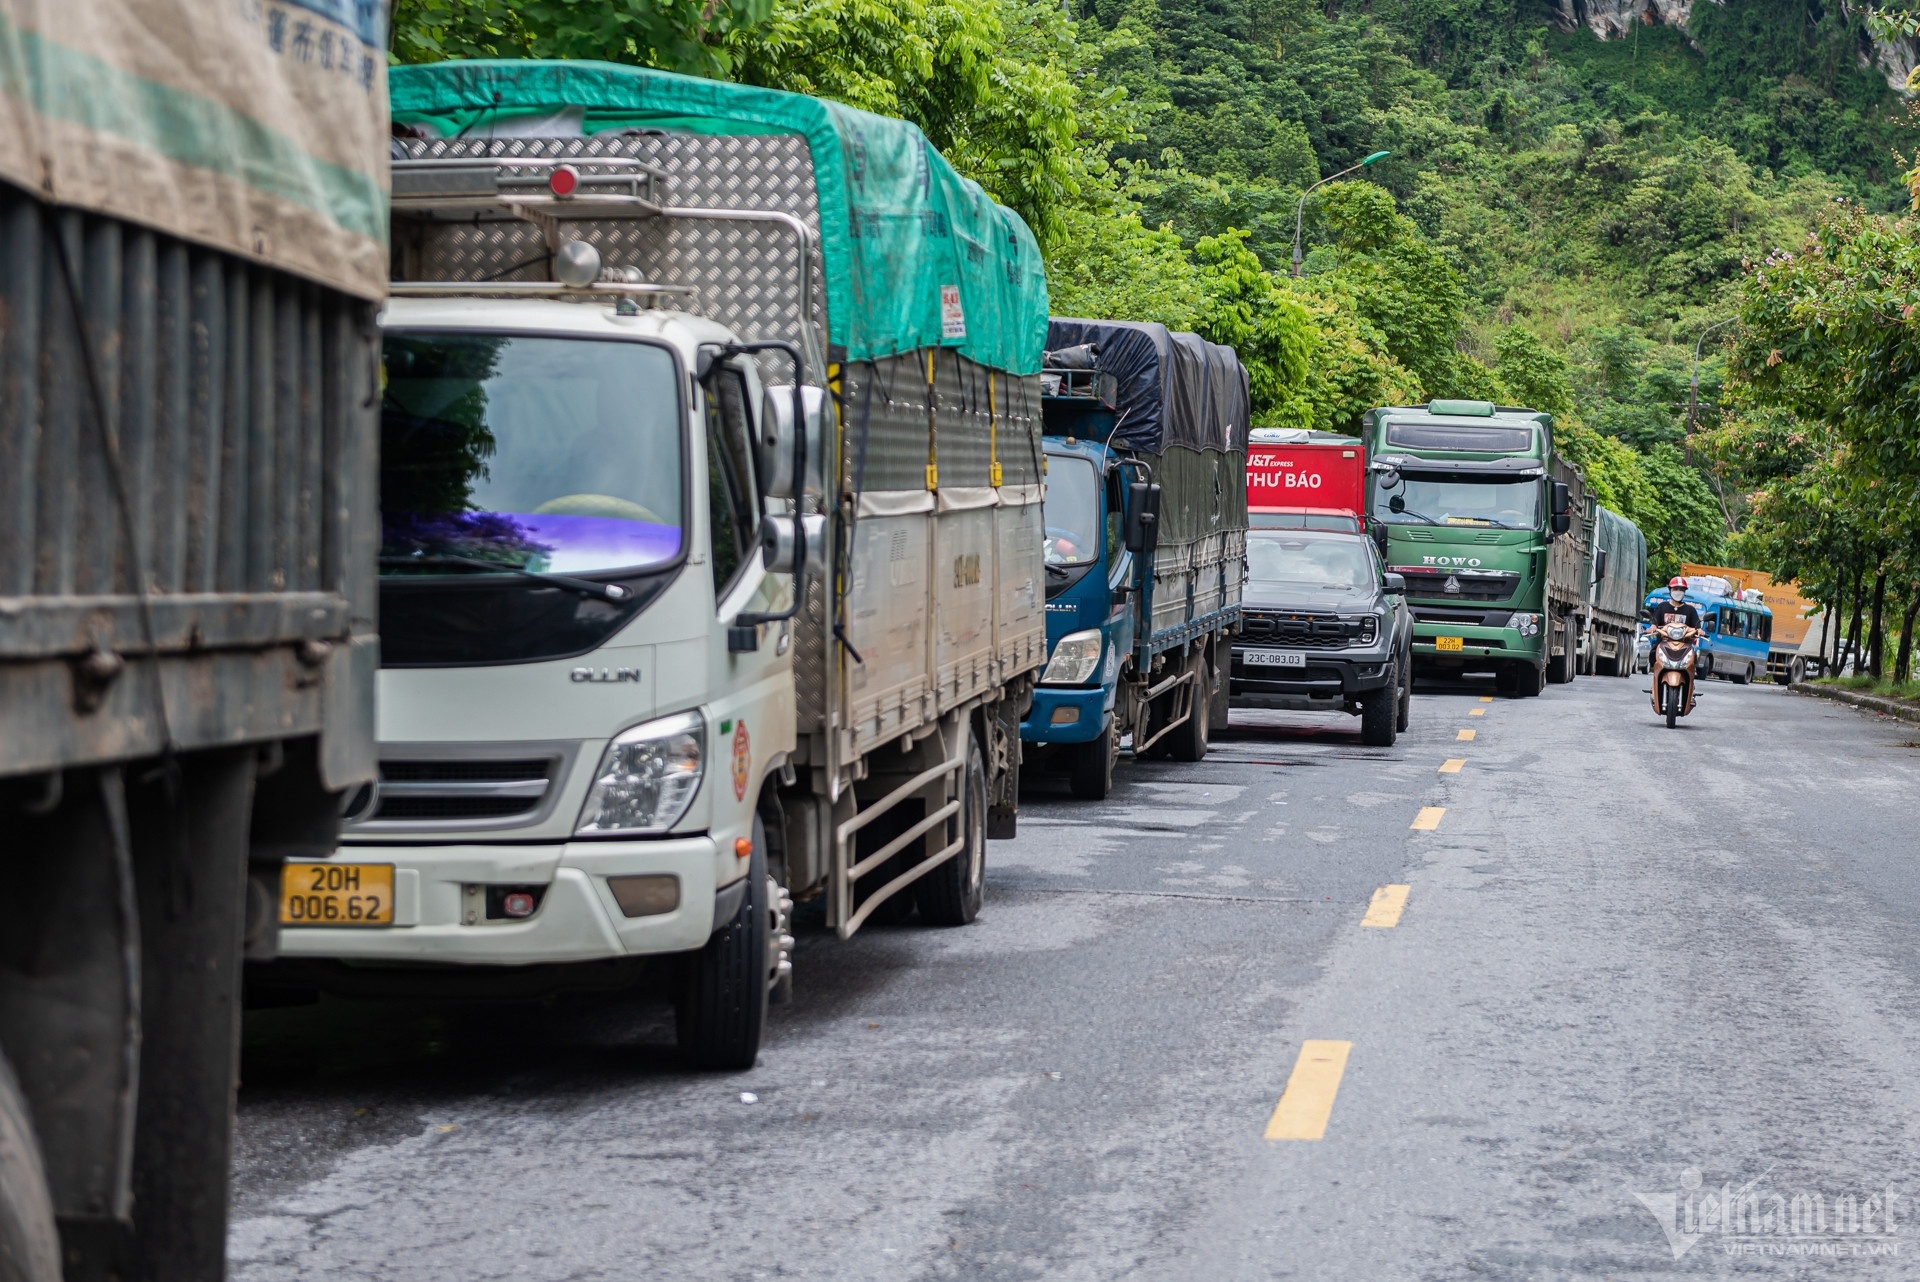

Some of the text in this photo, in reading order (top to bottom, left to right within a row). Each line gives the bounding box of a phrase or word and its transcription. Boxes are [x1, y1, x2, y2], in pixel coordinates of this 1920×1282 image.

[1246, 455, 1276, 467] J&T
[1246, 471, 1322, 488] THƯ BÁO
[1422, 555, 1481, 567] HOWO
[1044, 603, 1077, 612] OLLIN
[1248, 653, 1301, 665] 23C-083.03
[570, 667, 641, 683] OLLIN
[311, 866, 360, 891] 20H
[289, 894, 381, 920] 006.62
